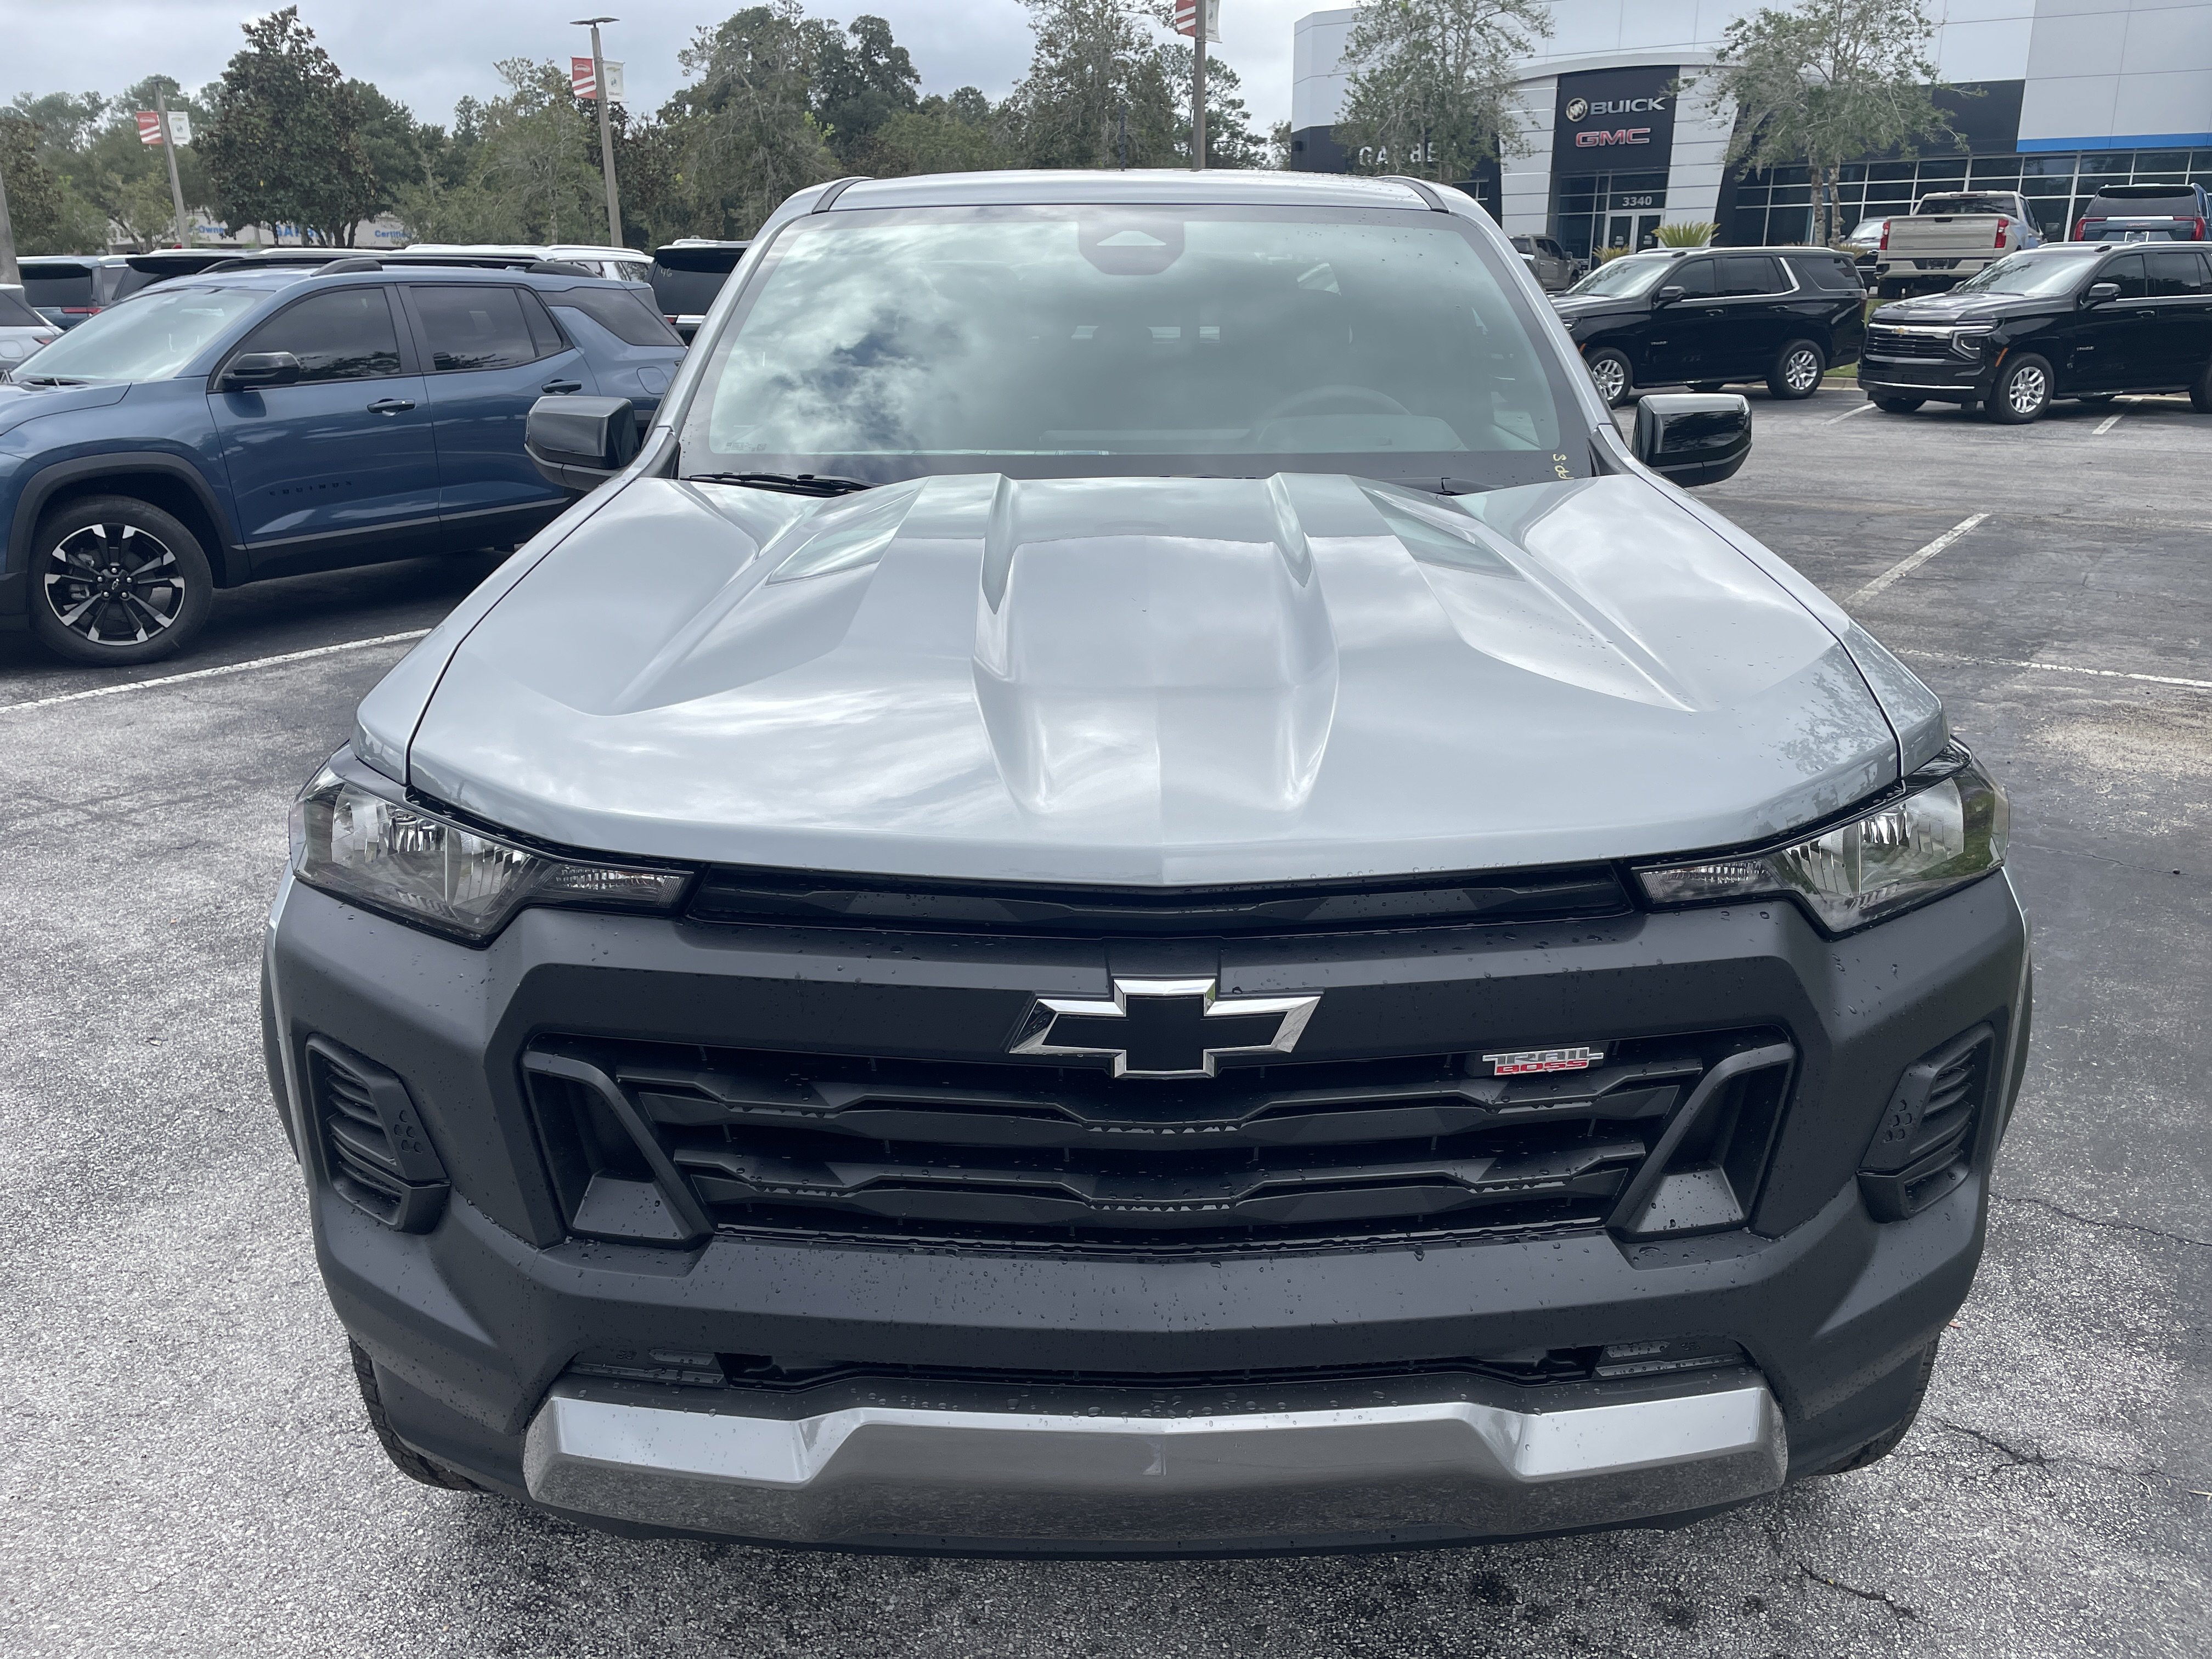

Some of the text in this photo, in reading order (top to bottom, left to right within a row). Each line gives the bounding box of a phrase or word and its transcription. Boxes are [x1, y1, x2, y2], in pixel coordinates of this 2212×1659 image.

[1591, 97, 1666, 115] BUICK
[1576, 128, 1651, 148] GMC
[1622, 196, 1652, 206] 3340
[661, 268, 673, 278] 46
[1482, 1047, 1604, 1065] TRAIL
[1495, 1059, 1589, 1075] BOSS
